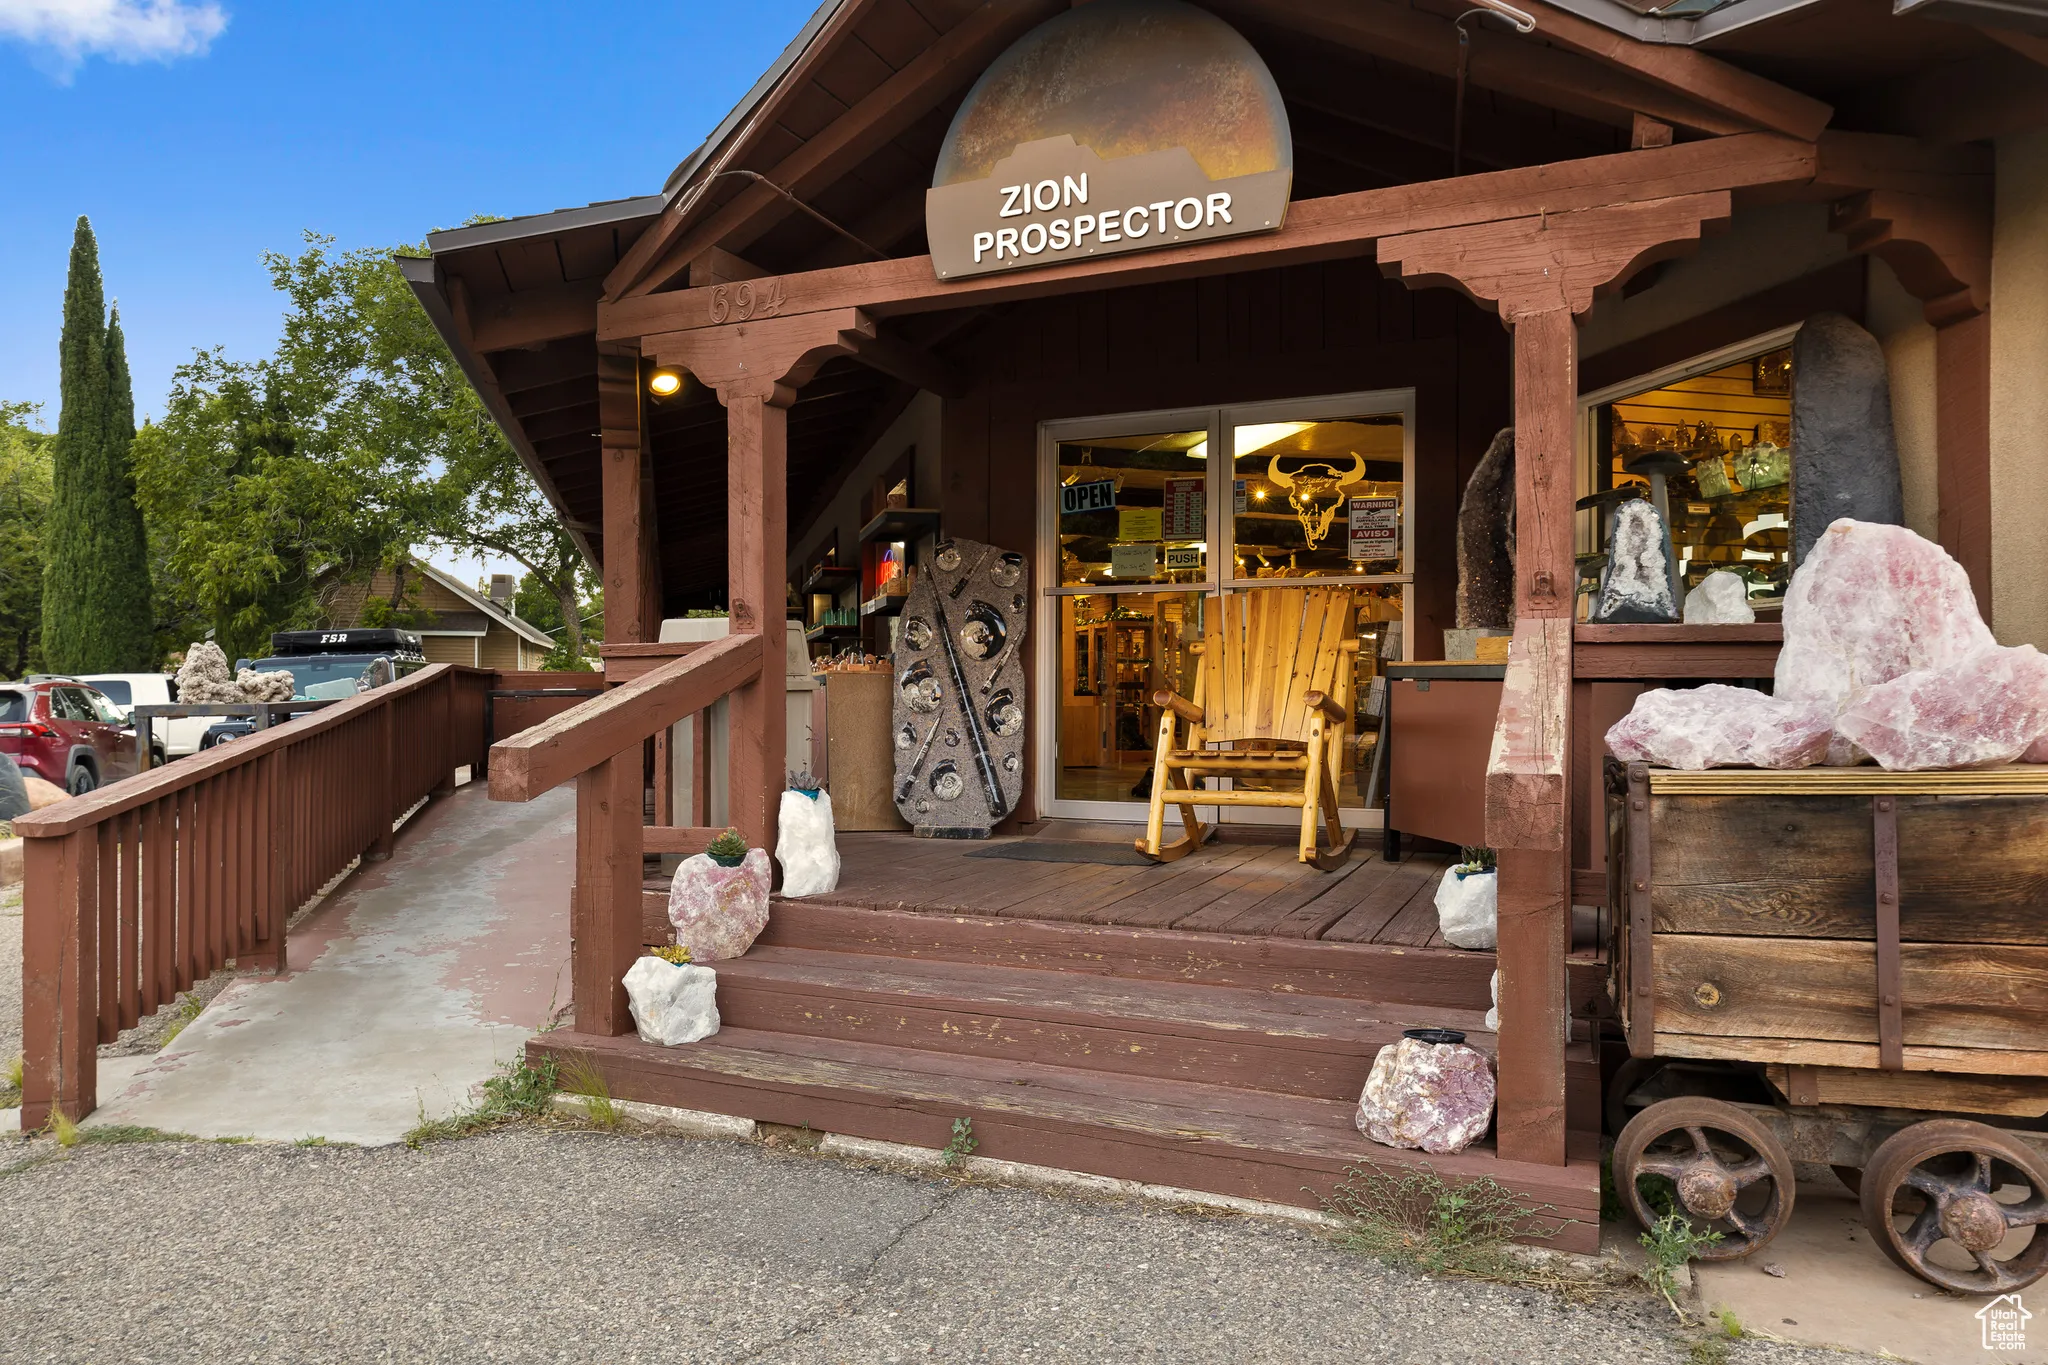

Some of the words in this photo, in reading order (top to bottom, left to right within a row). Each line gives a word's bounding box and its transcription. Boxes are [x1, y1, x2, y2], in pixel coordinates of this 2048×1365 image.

[999, 172, 1088, 218] ZION
[973, 191, 1233, 264] PROSPECTOR
[708, 276, 786, 324] 694
[1064, 483, 1112, 511] OPEN
[1352, 501, 1394, 509] WARNING
[1356, 530, 1389, 538] AVISO
[1168, 554, 1197, 564] PUSH
[320, 633, 347, 644] FSR
